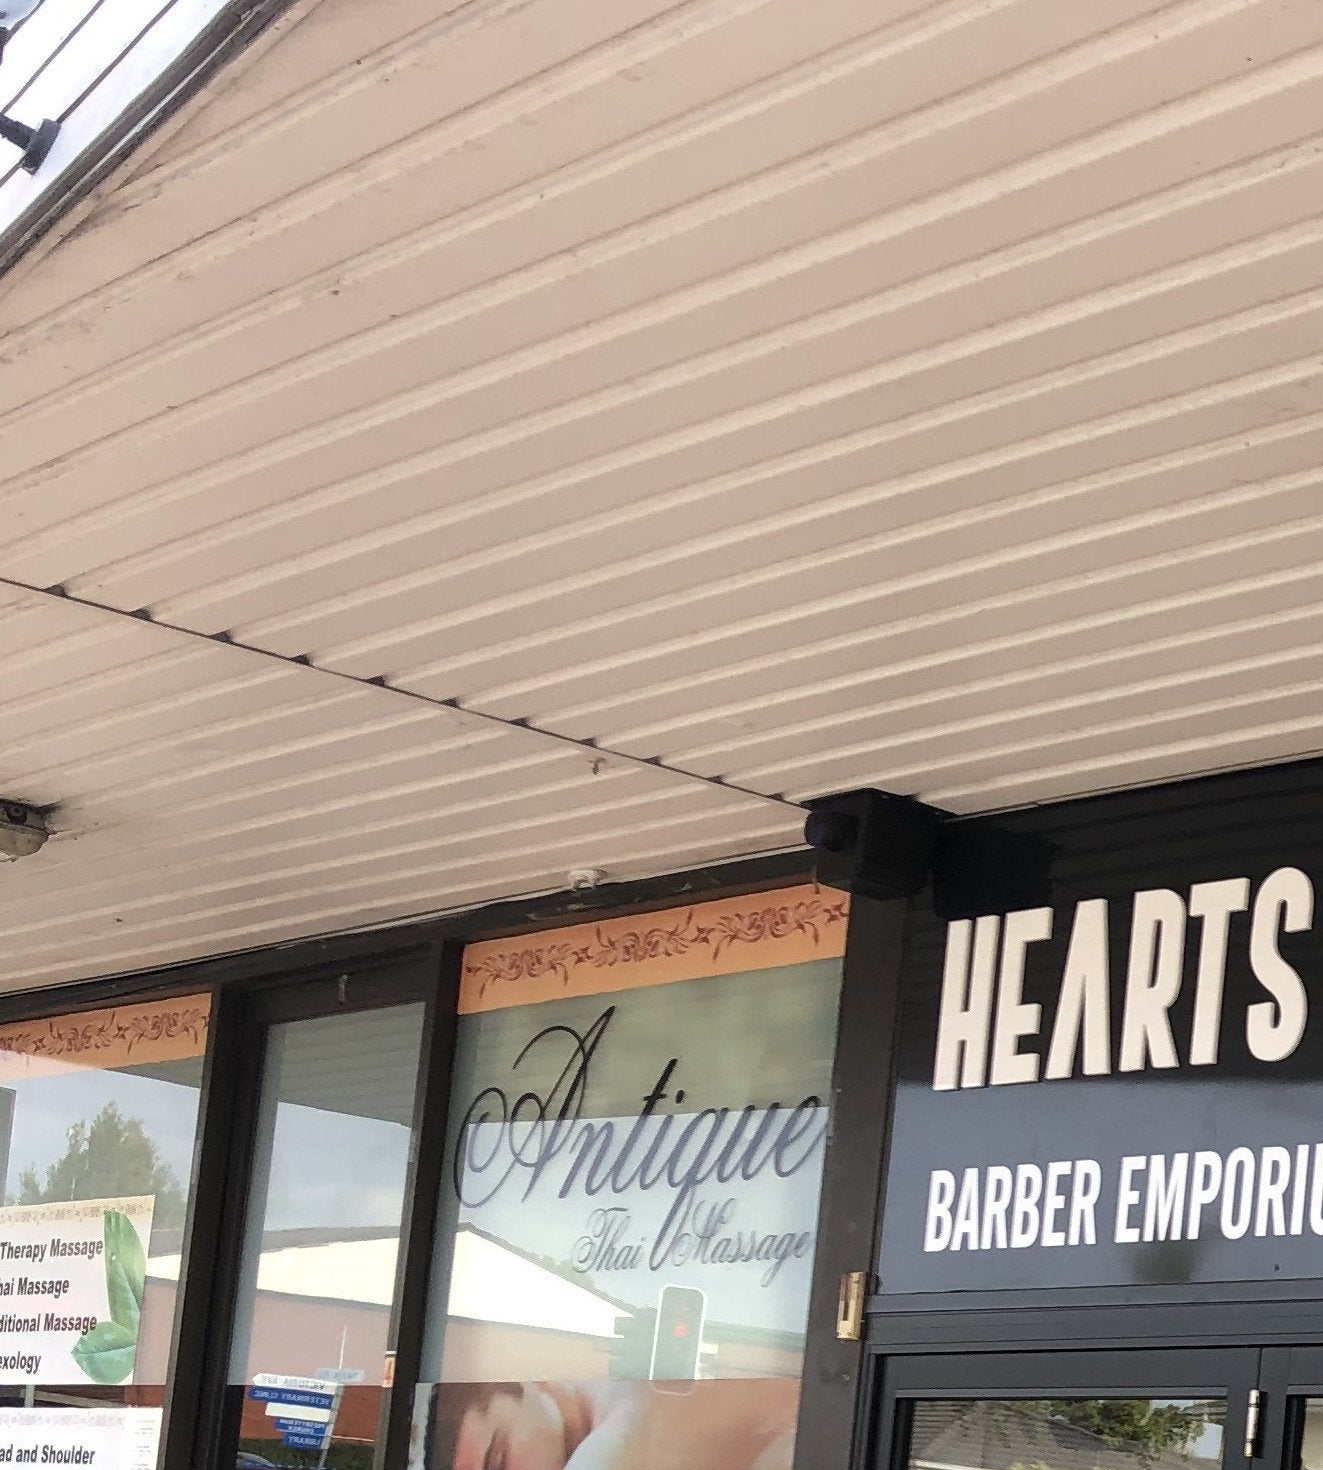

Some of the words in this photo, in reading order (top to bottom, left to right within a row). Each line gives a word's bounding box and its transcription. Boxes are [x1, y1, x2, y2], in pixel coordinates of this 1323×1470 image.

[931, 865, 1315, 1092] HEARTS
[454, 1005, 828, 1271] Antique
[923, 1160, 1097, 1253] BARBER
[50, 1238, 103, 1260] Massage
[572, 1206, 645, 1273] Thai
[670, 1198, 811, 1287] Massage
[17, 1276, 69, 1299] Massage
[44, 1312, 98, 1336] Massage
[16, 1445, 38, 1463] and
[41, 1444, 95, 1465] Shoulder
